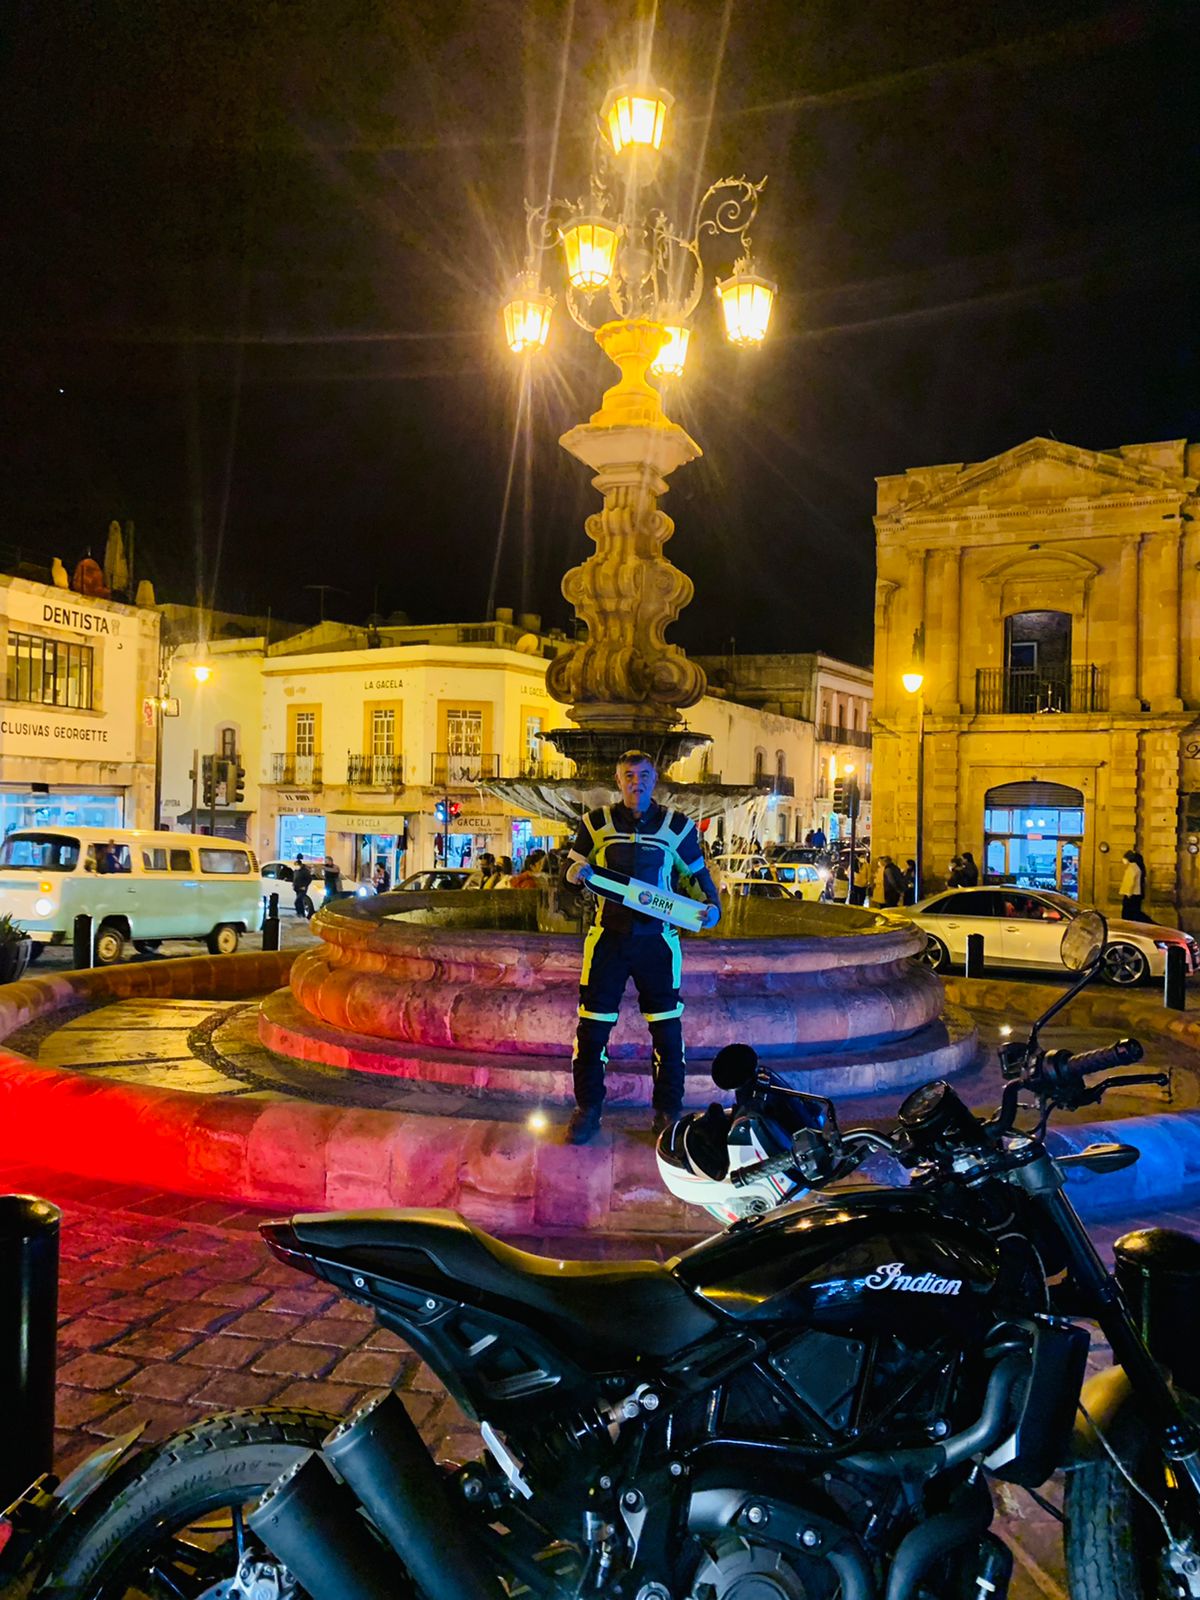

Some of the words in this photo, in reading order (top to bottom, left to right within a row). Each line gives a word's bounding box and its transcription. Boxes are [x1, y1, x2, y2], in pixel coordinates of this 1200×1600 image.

[43, 604, 110, 634] DENTISTA
[364, 680, 374, 690] LA
[376, 679, 404, 689] GACELA
[54, 726, 109, 743] GEORGETTE
[457, 818, 492, 827] GACELA
[652, 896, 674, 911] RRM
[865, 1262, 963, 1296] Indian
